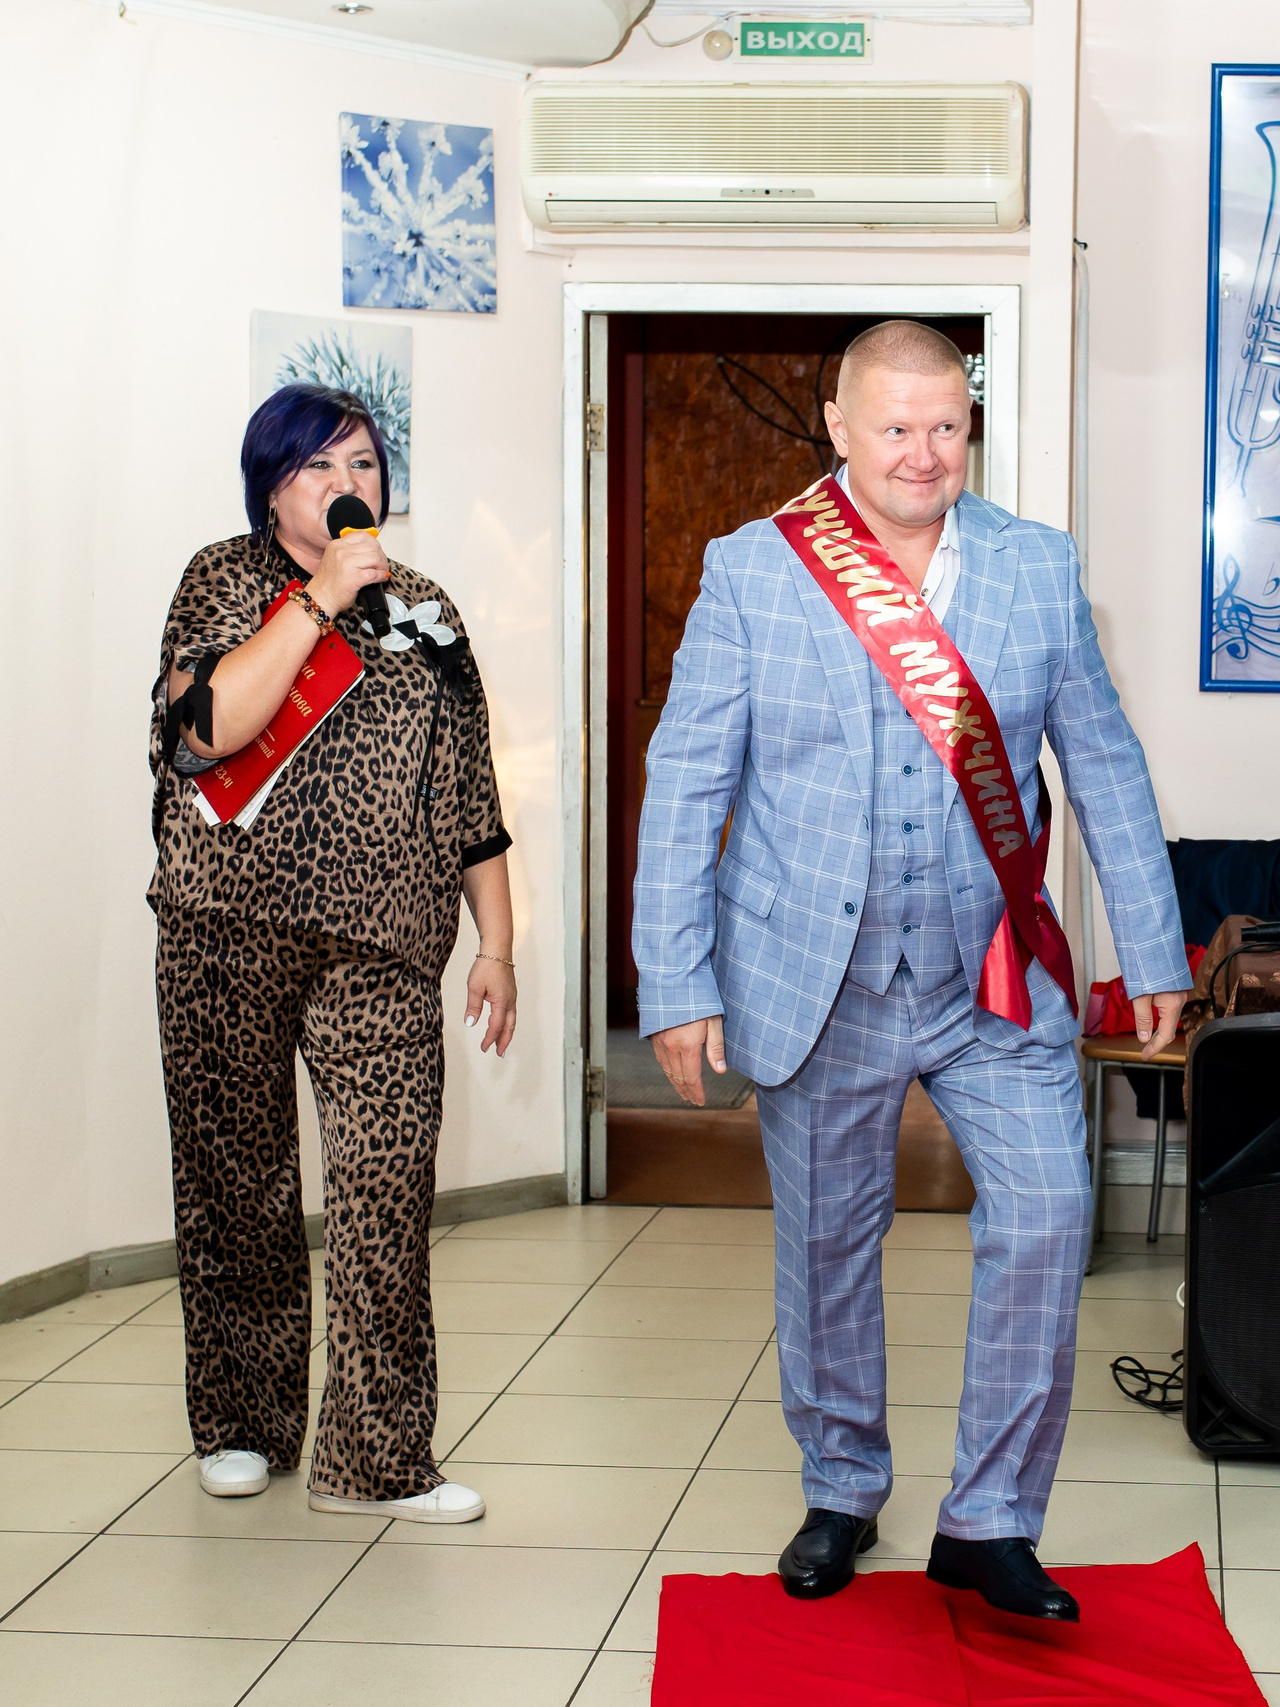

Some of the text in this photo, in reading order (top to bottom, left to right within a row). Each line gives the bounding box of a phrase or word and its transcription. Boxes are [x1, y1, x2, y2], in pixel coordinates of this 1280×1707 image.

[746, 31, 863, 54] ВЫХОД
[787, 482, 1025, 858] УЧШИЙ МУЖЧИНА
